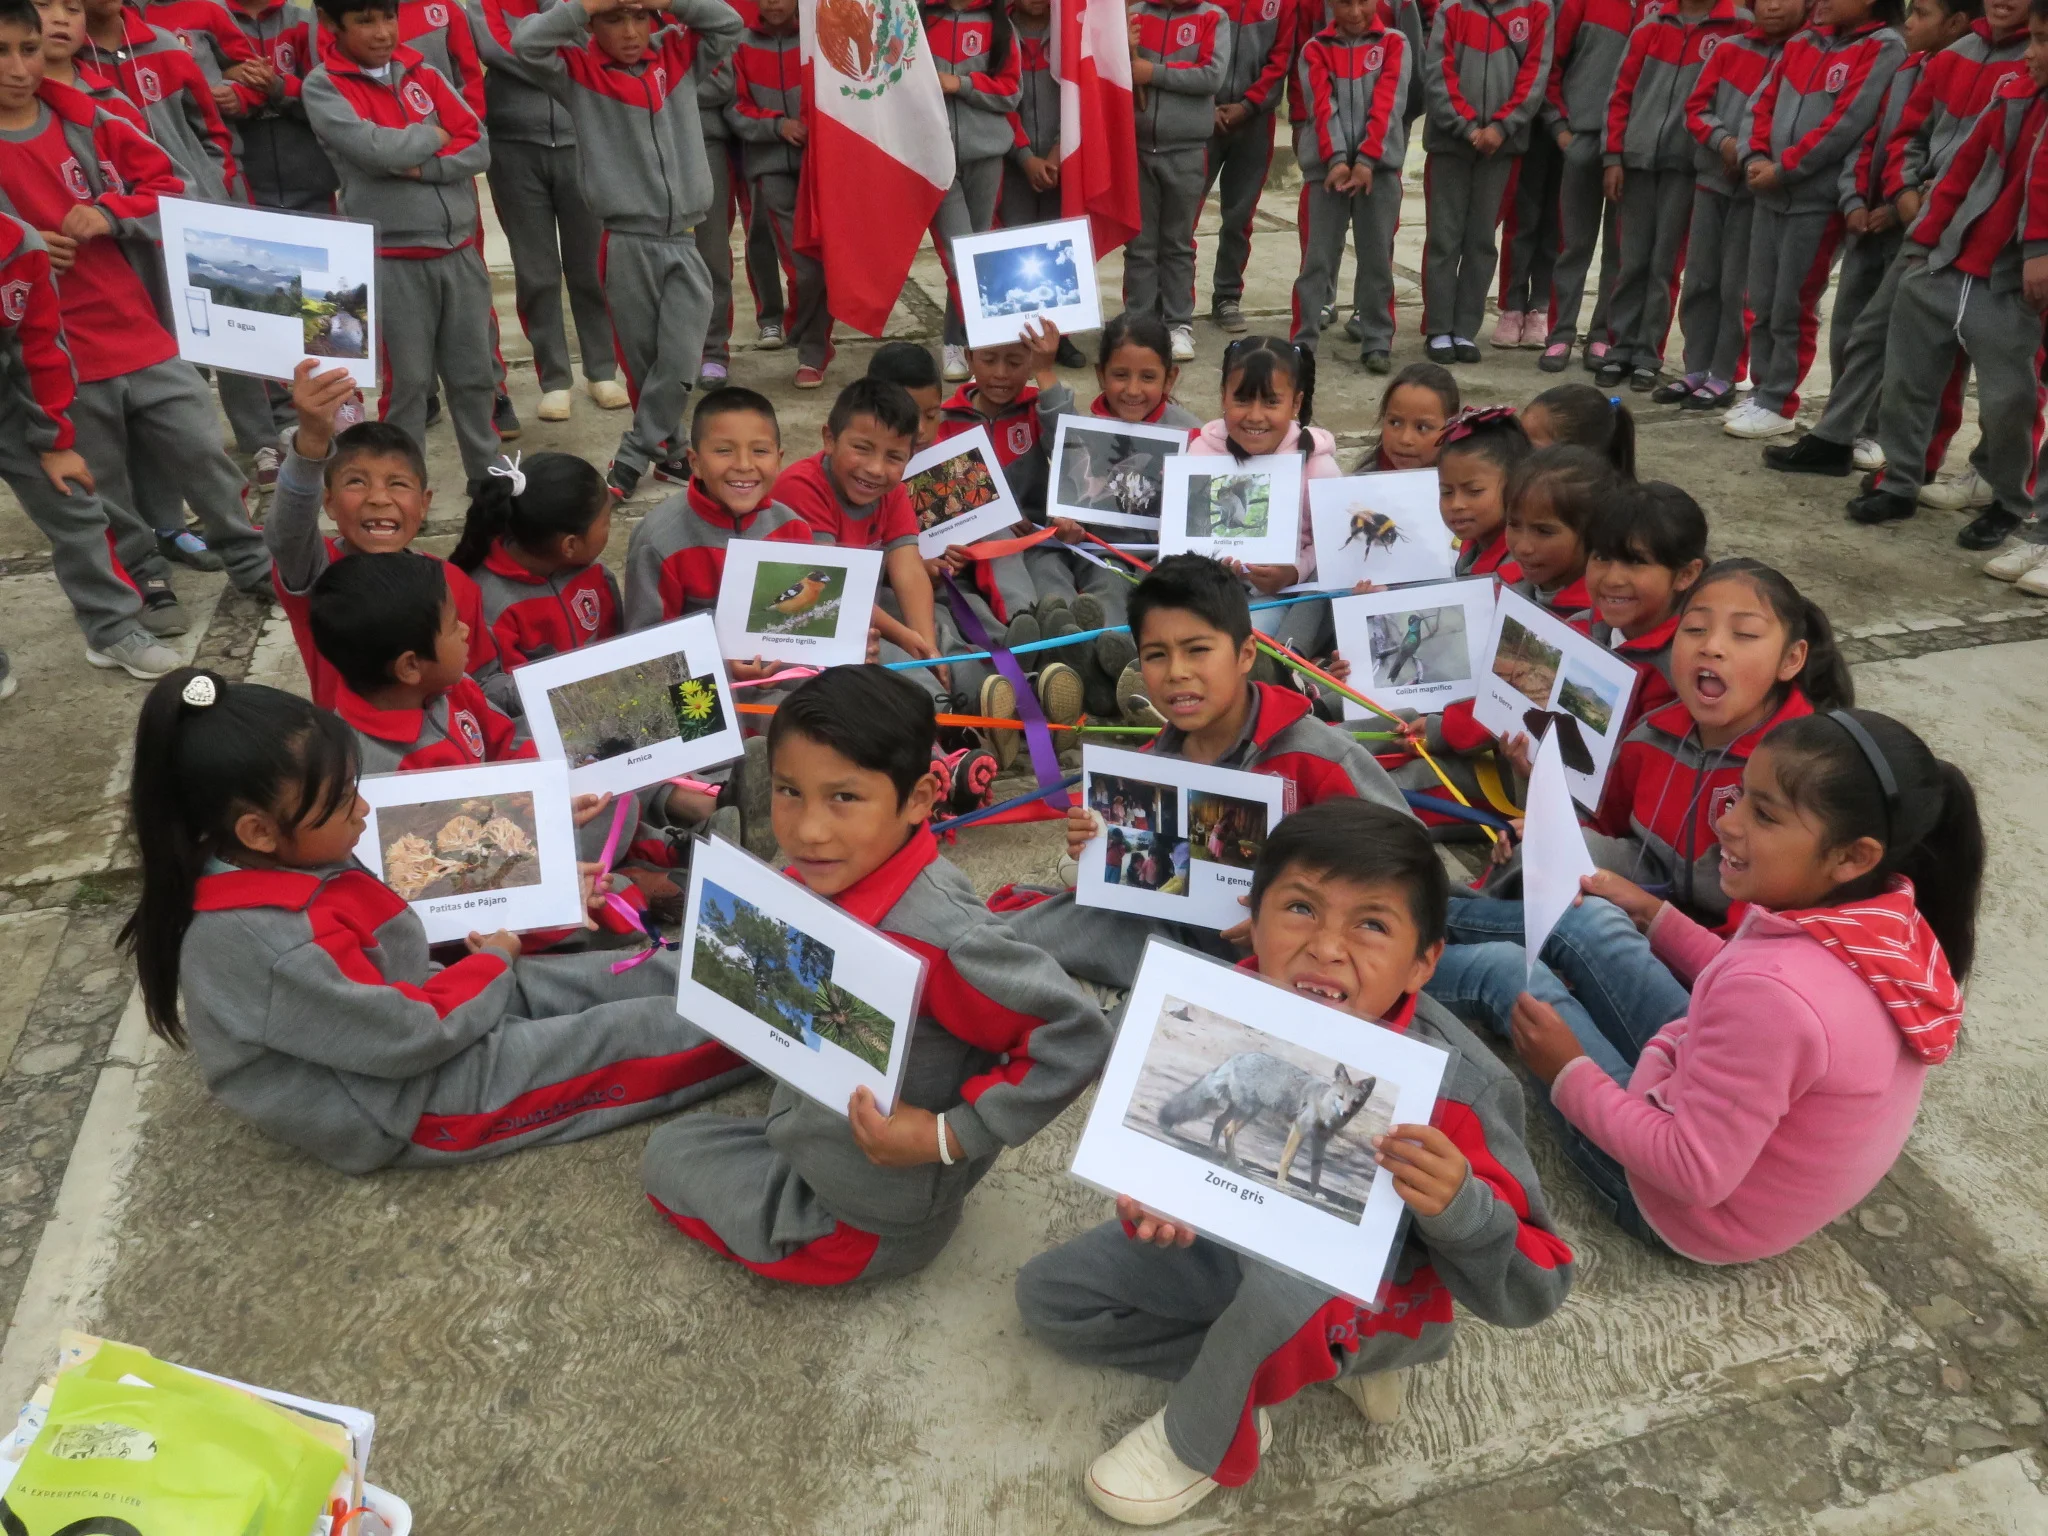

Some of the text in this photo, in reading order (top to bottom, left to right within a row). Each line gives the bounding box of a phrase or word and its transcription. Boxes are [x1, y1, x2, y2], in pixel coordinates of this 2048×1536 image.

[227, 319, 256, 332] El agua
[928, 514, 978, 538] Mariposa monarca
[762, 635, 817, 646] Picogordo tigrillo
[1216, 873, 1253, 888] La gente
[429, 896, 508, 914] Patitas de Pájaro
[770, 1030, 791, 1048] Pino
[1204, 1170, 1265, 1205] Zorra gris
[30, 1488, 99, 1499] EXPERIENCIA
[103, 1491, 117, 1501] DE
[120, 1495, 142, 1507] LEER
